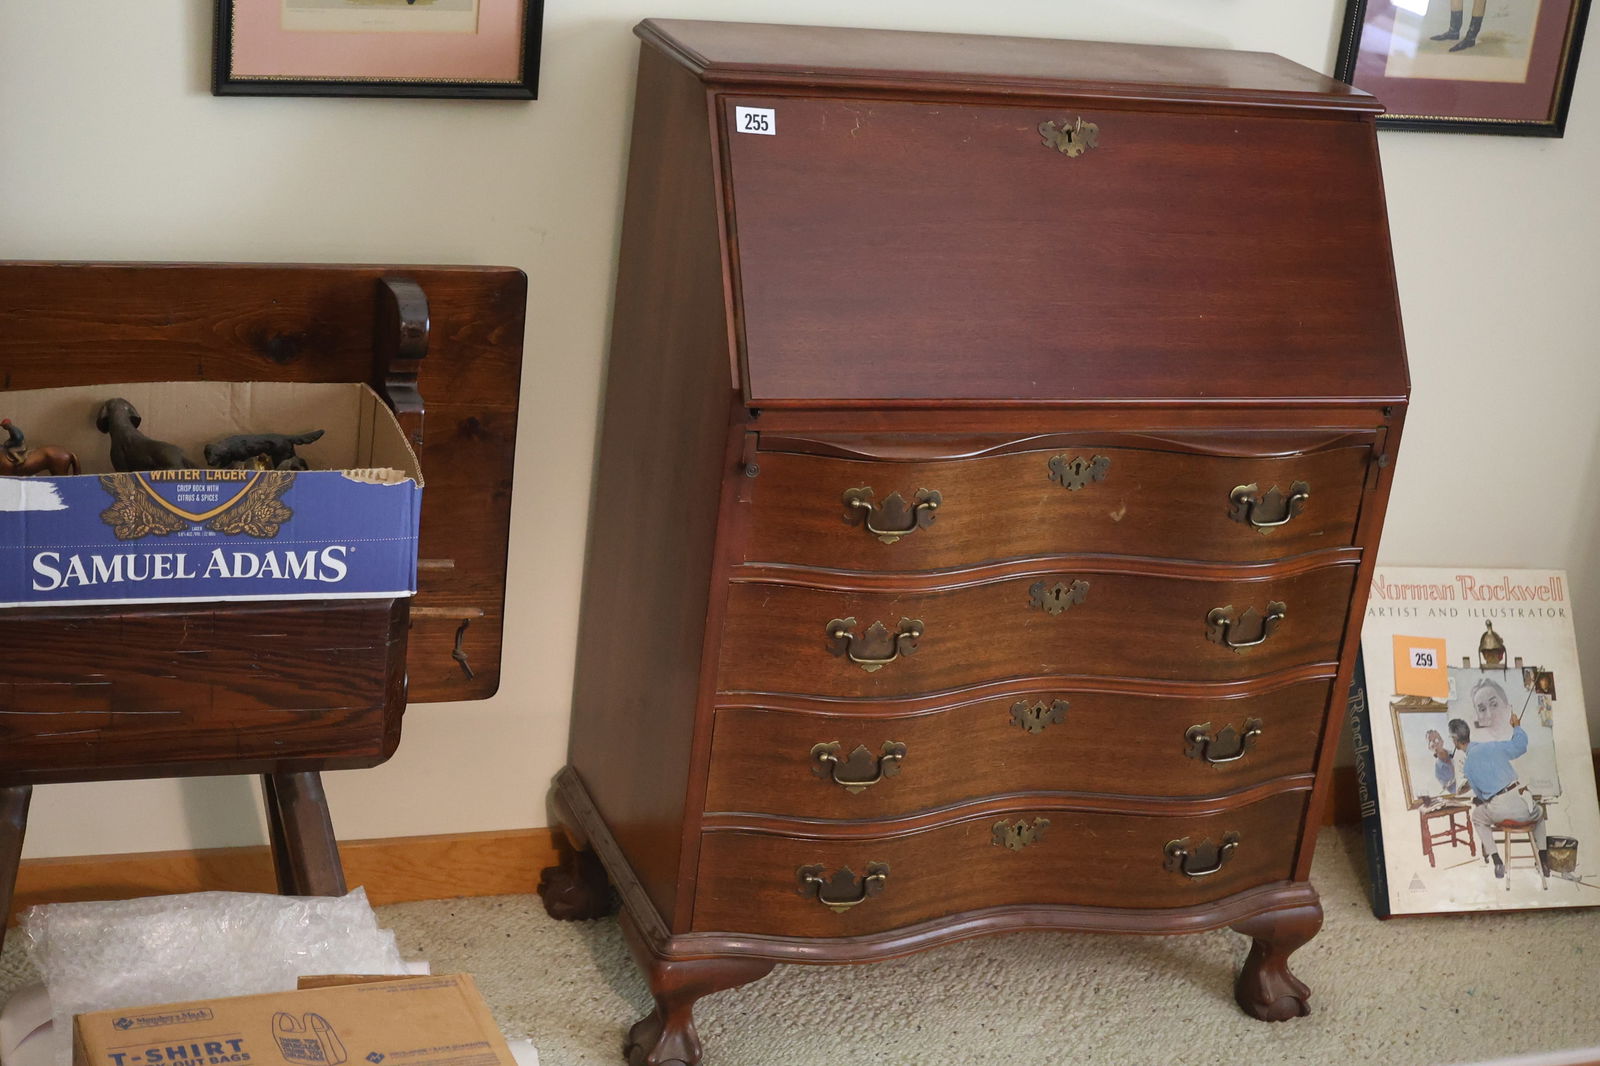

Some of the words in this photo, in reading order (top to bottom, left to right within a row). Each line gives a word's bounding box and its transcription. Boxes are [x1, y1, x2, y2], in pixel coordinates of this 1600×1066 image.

[744, 113, 769, 131] 255
[150, 470, 200, 480] WINTER
[206, 470, 247, 480] LAGER
[176, 484, 191, 492] CRISP
[192, 484, 206, 492] BOCK
[206, 484, 219, 492] WITH
[177, 494, 195, 502] CITRUS
[201, 494, 219, 502] SPICES
[32, 551, 196, 591] SAMUEL
[203, 545, 348, 583] ADAMS
[1368, 574, 1456, 601] Norman
[1456, 574, 1564, 602] Rockwell
[1368, 607, 1418, 617] ARTIST
[1428, 608, 1458, 618] AND
[1468, 608, 1566, 618] ILLUSTRATOR
[1415, 652, 1433, 667] 259
[107, 1038, 244, 1066] T-SHIRT
[209, 1052, 251, 1064] BAGS
